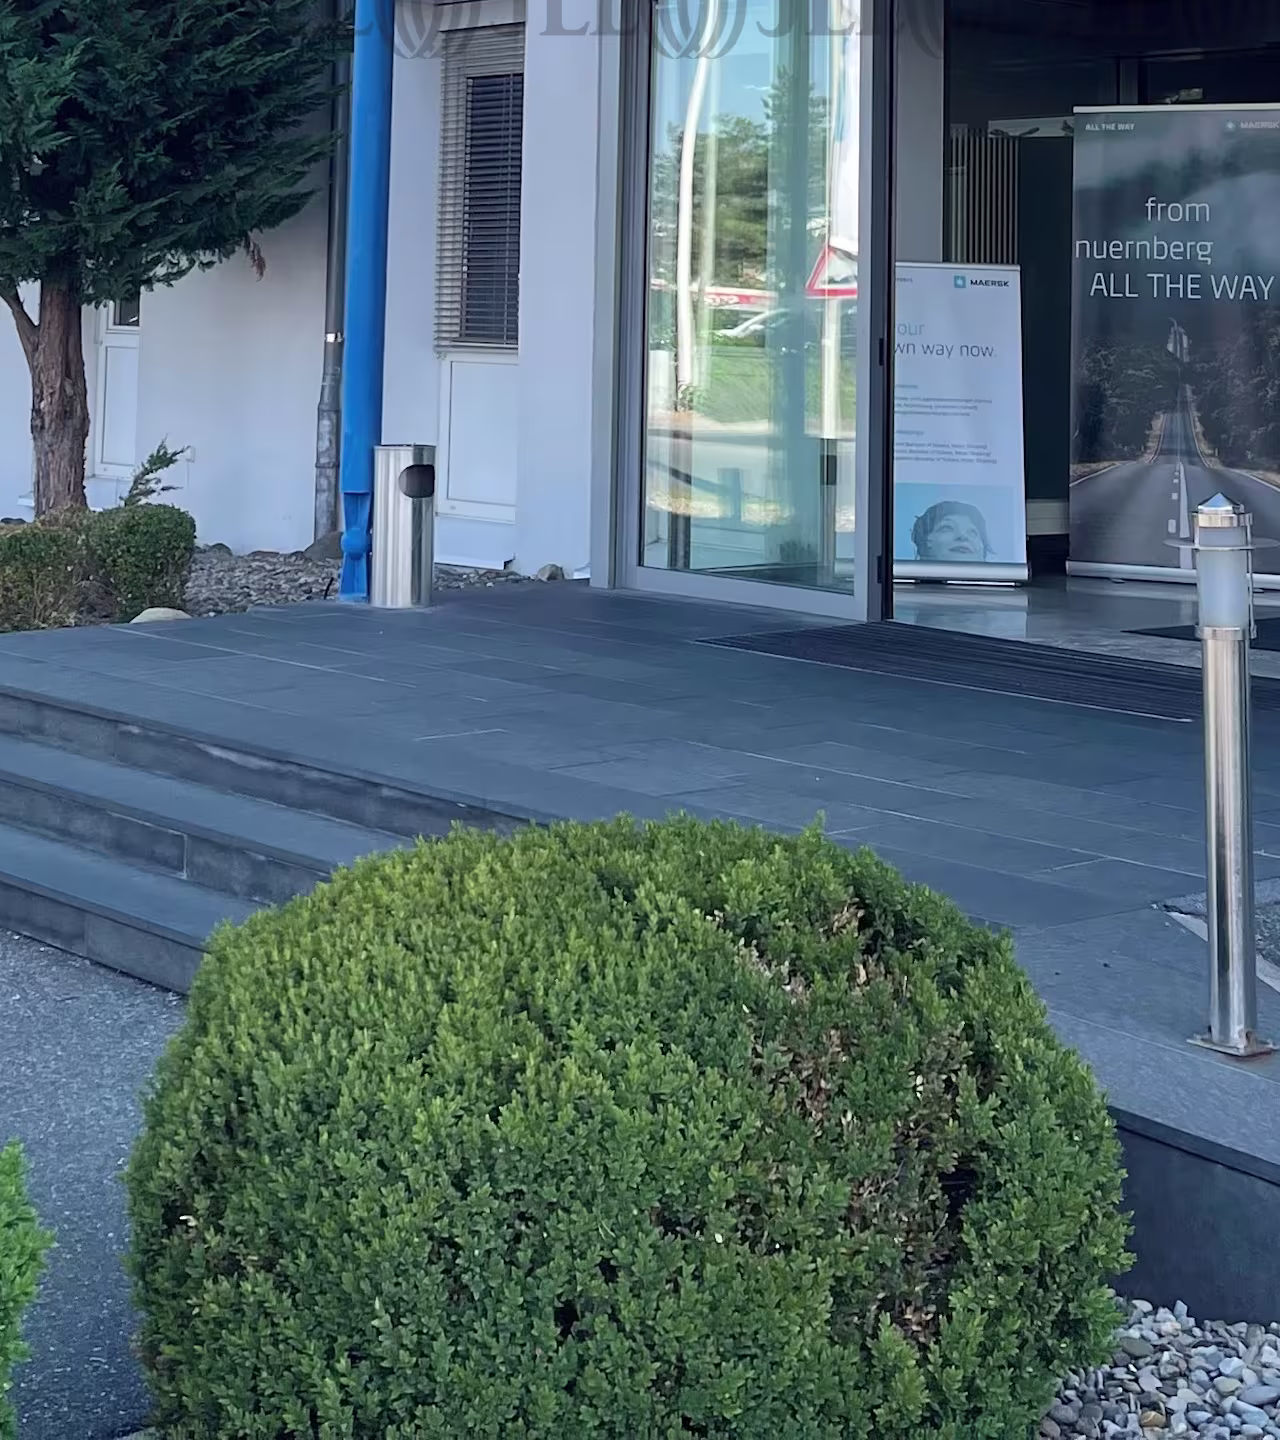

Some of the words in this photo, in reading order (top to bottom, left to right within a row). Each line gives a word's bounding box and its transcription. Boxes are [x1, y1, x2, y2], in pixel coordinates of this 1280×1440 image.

[1085, 122, 1100, 131] ALL
[1101, 122, 1116, 131] THE
[1117, 122, 1135, 131] WAY
[1145, 196, 1210, 222] from
[1075, 235, 1214, 265] nuernberg
[970, 279, 1010, 288] MAERSK
[1089, 272, 1139, 298] ALL
[1147, 273, 1202, 300] THE
[1210, 275, 1275, 302] WAY
[895, 322, 925, 336] our
[921, 343, 955, 359] way
